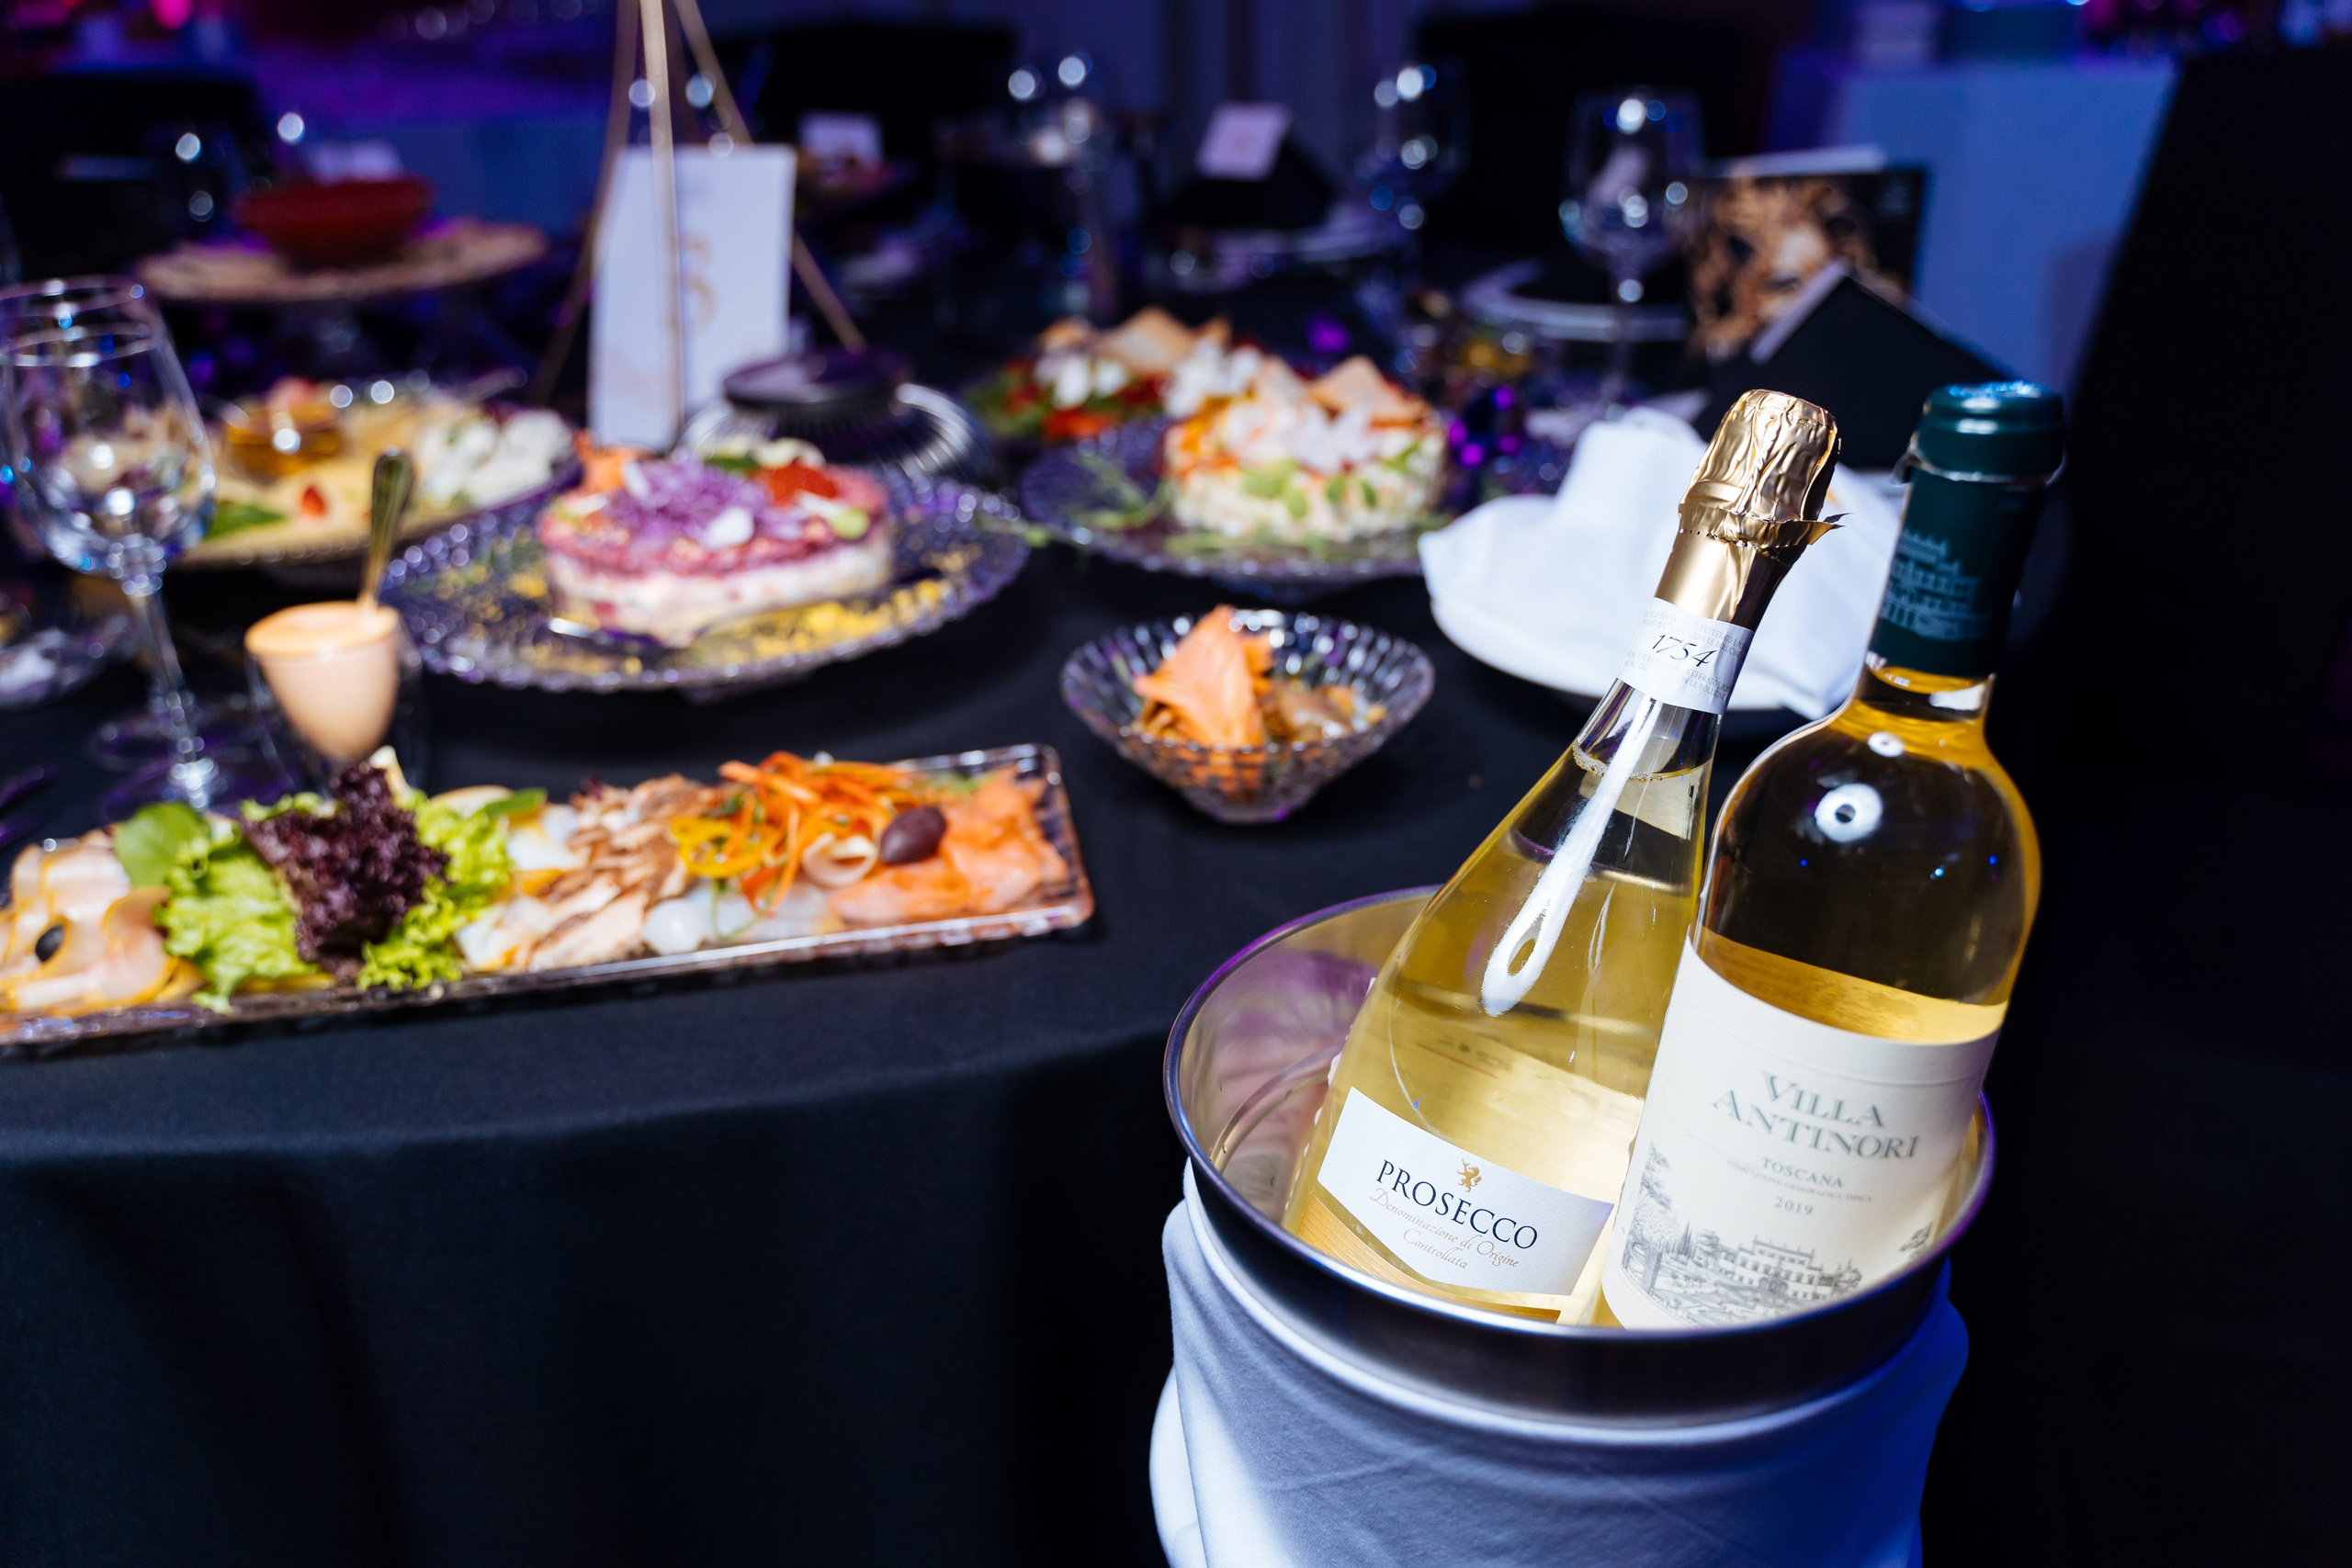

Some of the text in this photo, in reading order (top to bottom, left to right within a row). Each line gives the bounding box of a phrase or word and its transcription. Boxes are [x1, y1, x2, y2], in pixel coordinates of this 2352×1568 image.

[1652, 634, 1717, 668] 1754
[1686, 669, 1718, 687] ETTERATO
[1762, 1070, 1885, 1128] VILLA
[1712, 1089, 1920, 1159] ANTINORI
[1761, 1156, 1844, 1188] TOSCANA
[1375, 1158, 1538, 1249] PROSECCO
[1774, 1196, 1814, 1215] 2019
[1369, 1187, 1520, 1268] Denominazione di Origine
[1403, 1227, 1469, 1269] Controllata
